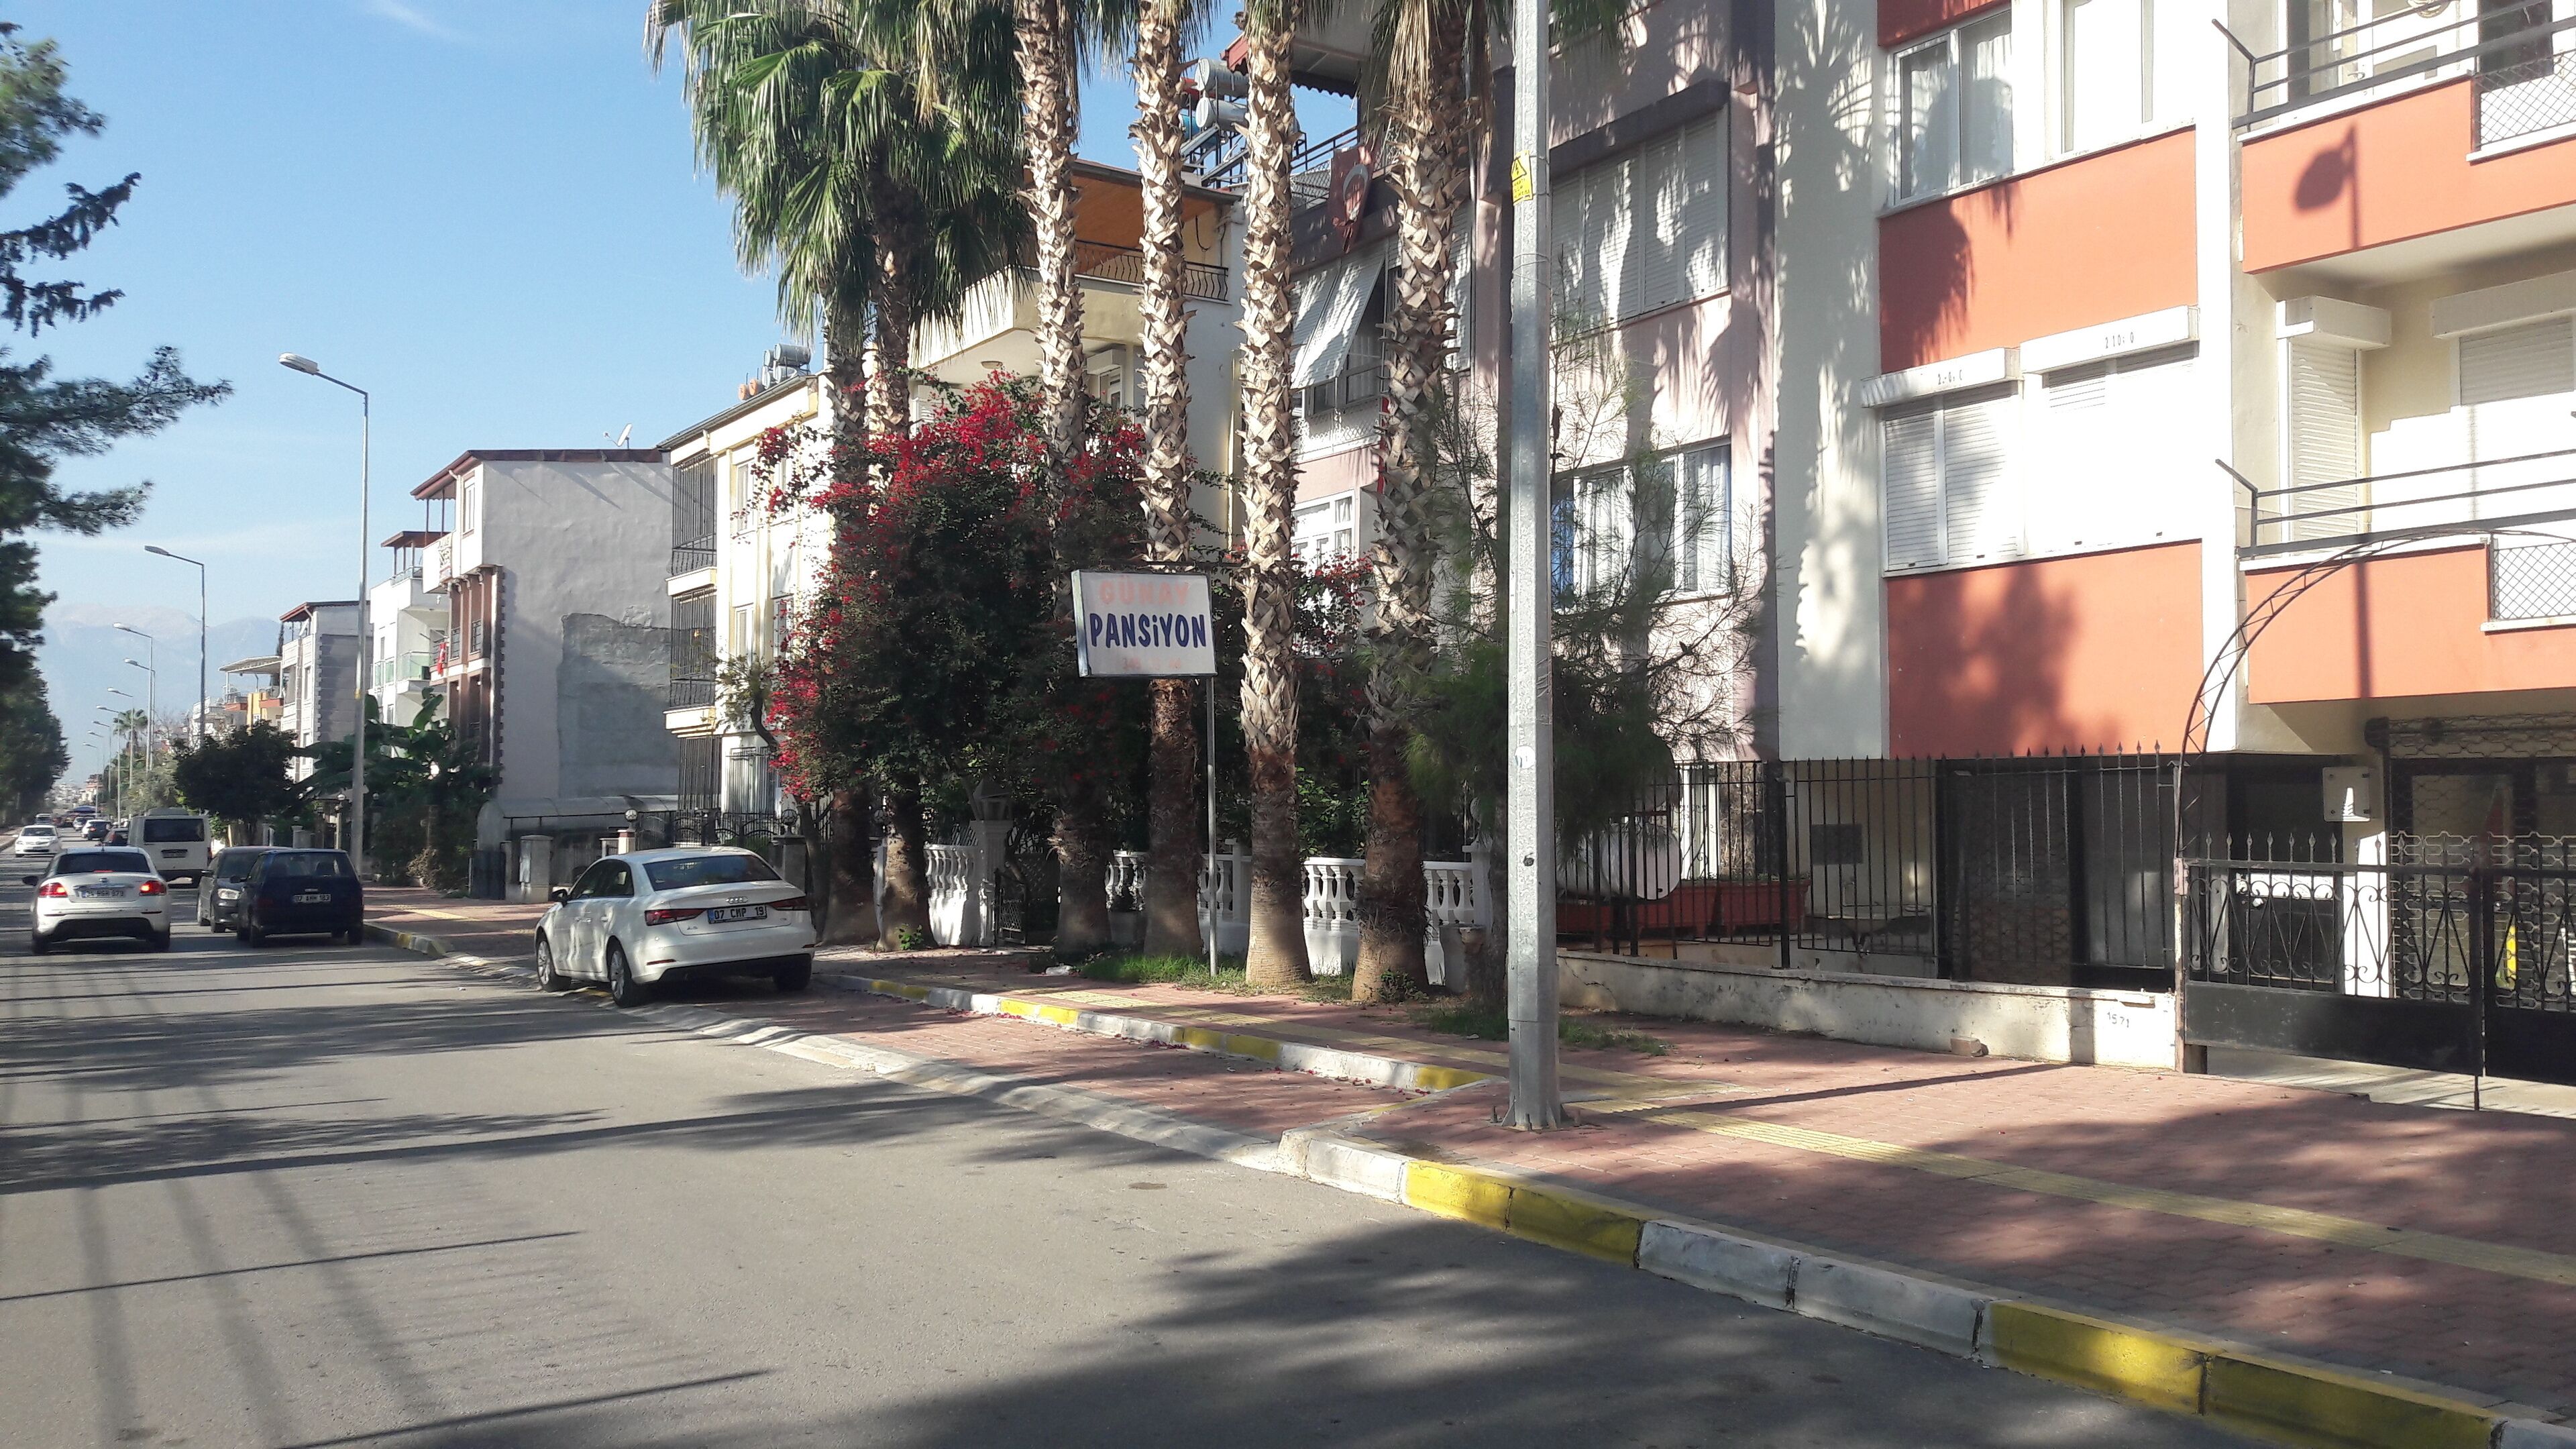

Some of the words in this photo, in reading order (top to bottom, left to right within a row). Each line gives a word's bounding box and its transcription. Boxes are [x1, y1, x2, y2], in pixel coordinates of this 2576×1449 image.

[1098, 575, 1189, 605] GÜNAY
[714, 910, 724, 920] 07
[755, 906, 765, 916] 19
[2106, 1012, 2129, 1028] 1571
